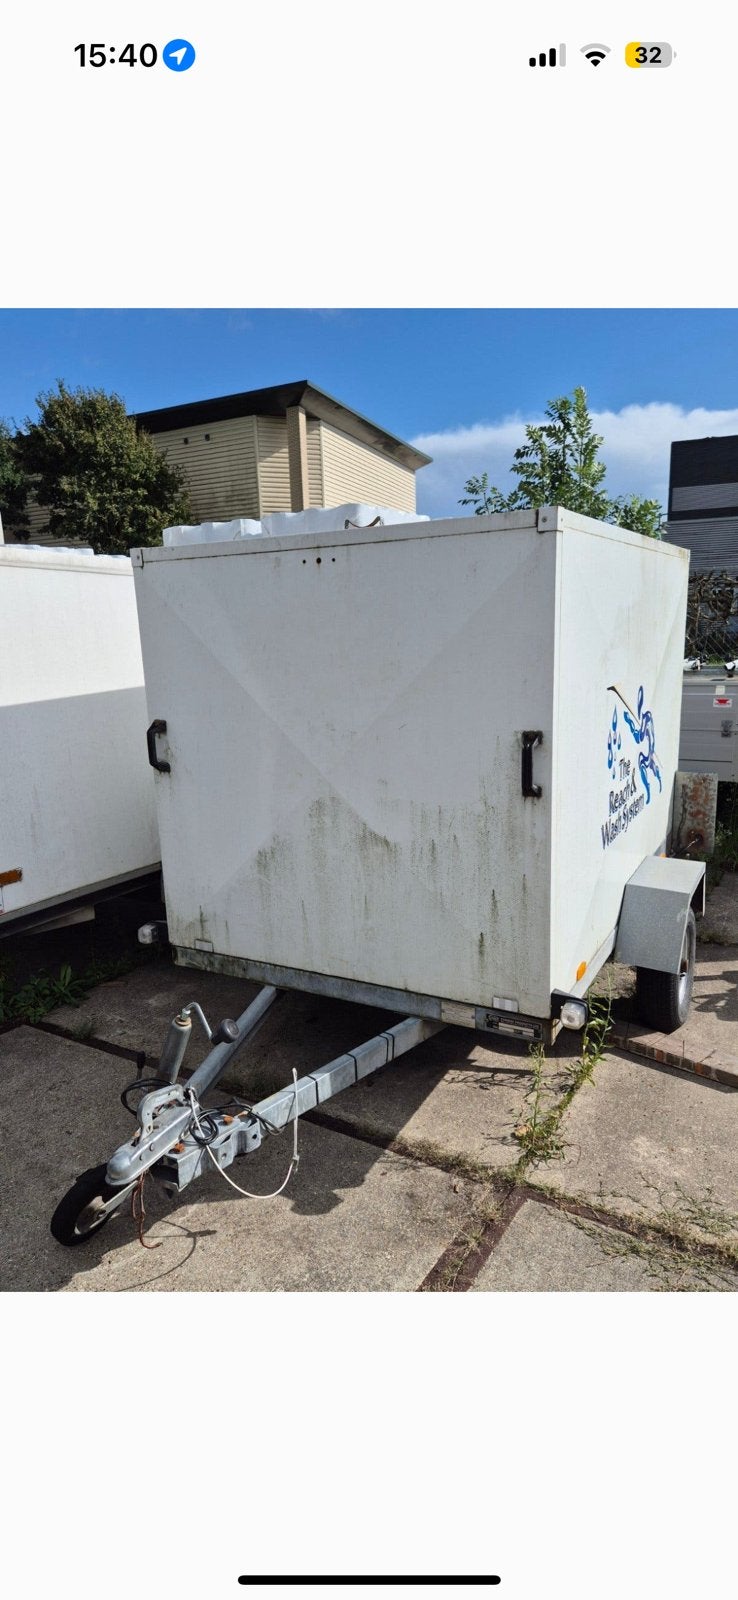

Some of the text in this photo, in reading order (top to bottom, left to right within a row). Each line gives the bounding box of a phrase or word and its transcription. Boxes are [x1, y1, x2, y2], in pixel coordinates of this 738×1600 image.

[609, 767, 637, 817] Reach &
[619, 757, 631, 781] The
[601, 793, 645, 850] Wash System
